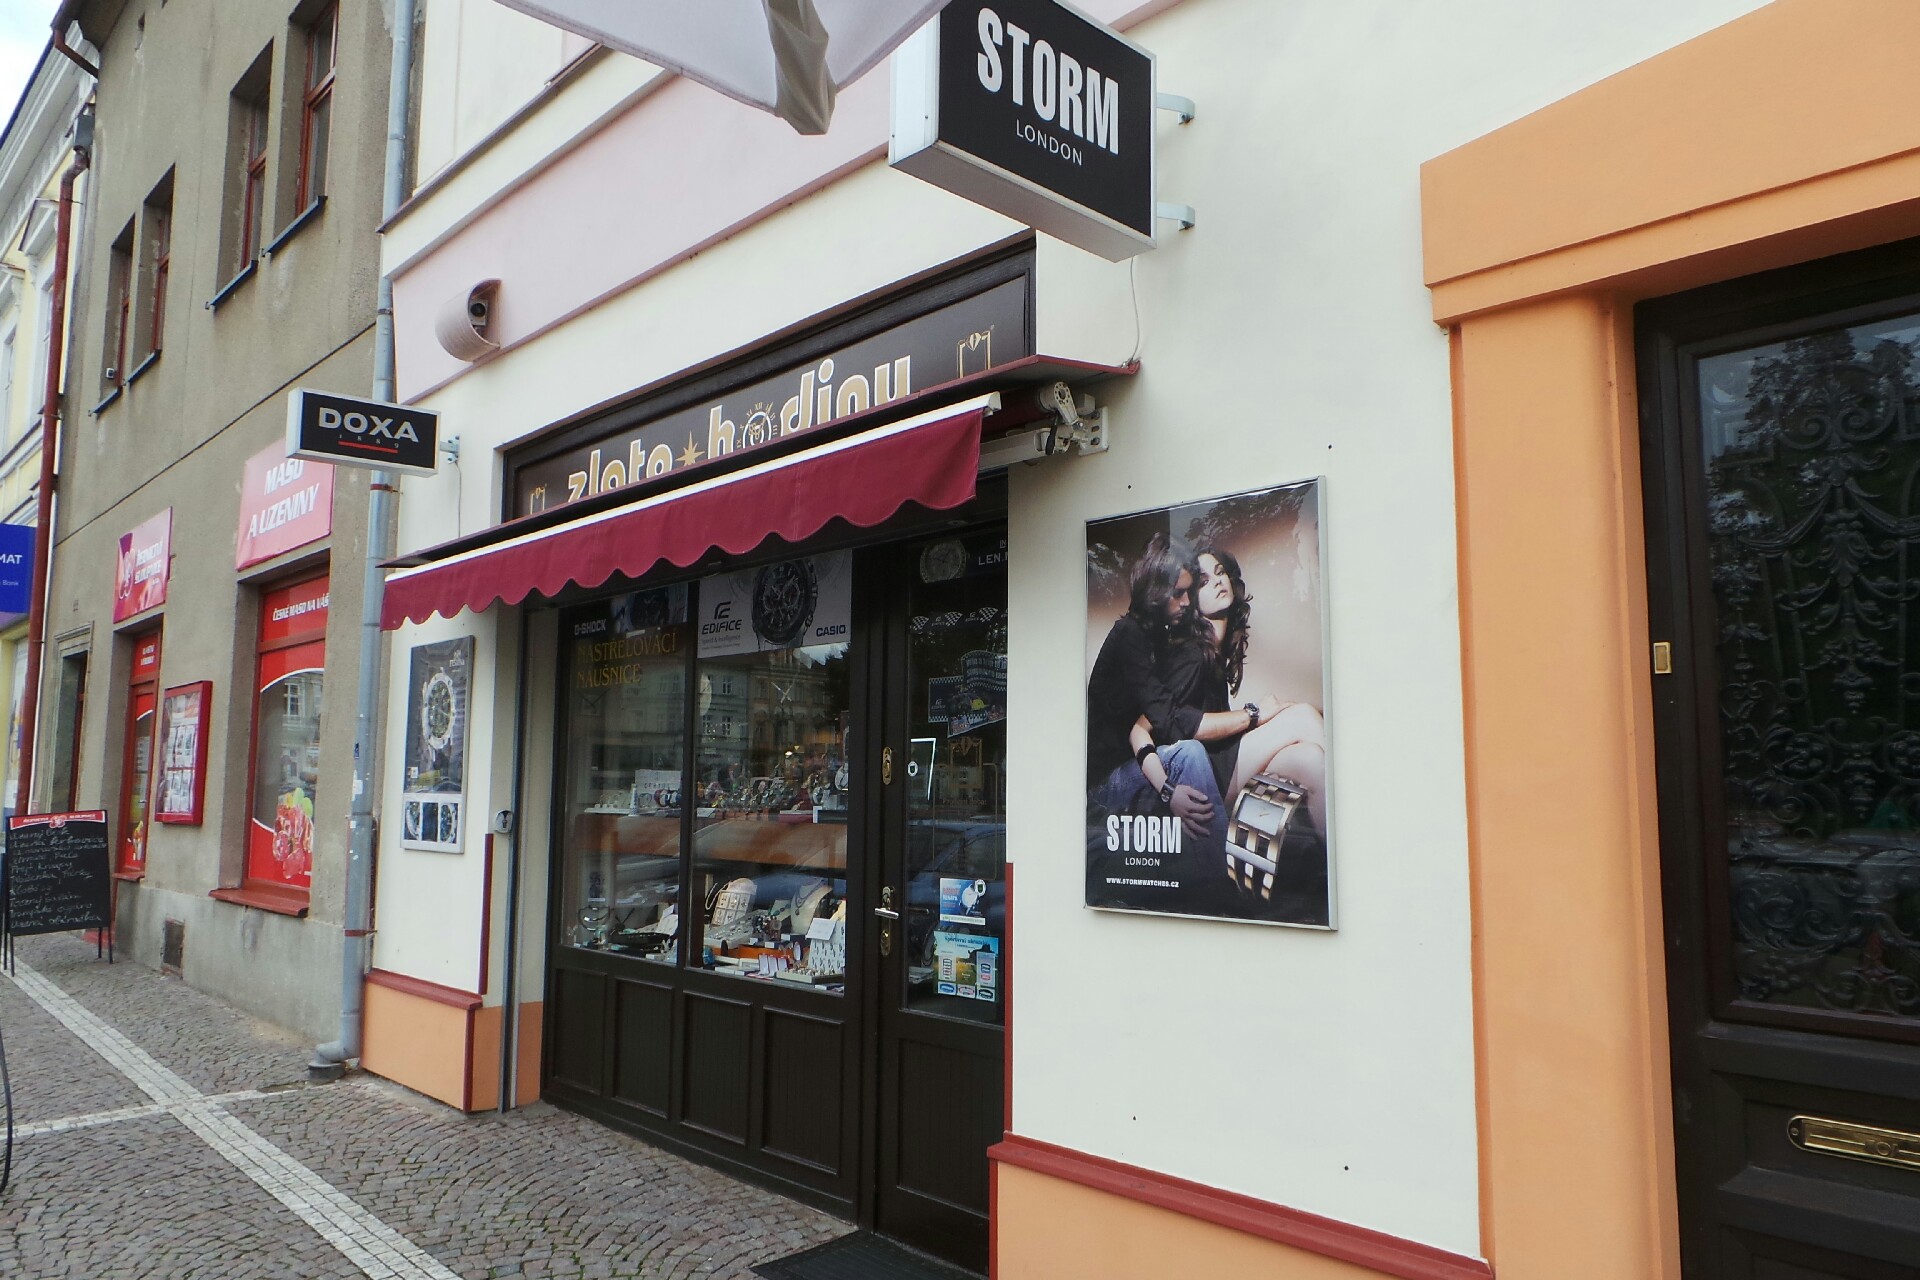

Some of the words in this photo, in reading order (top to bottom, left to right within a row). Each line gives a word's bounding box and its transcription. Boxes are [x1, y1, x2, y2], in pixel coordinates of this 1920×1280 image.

[977, 7, 1119, 156] STORM
[1016, 118, 1083, 166] LONDON
[318, 407, 419, 443] DOXA
[264, 458, 304, 496] MASO
[247, 513, 257, 540] A
[259, 482, 319, 534] UZENINY
[574, 619, 607, 636] G-SHOCK
[702, 619, 742, 635] EDIFICE
[816, 624, 846, 637] CASIO
[577, 664, 641, 688] NAUŠNICE
[1106, 814, 1182, 854] STORM
[1125, 857, 1161, 867] LONDON
[1106, 877, 1180, 889] WWW.STORMWATCHES.CZ
